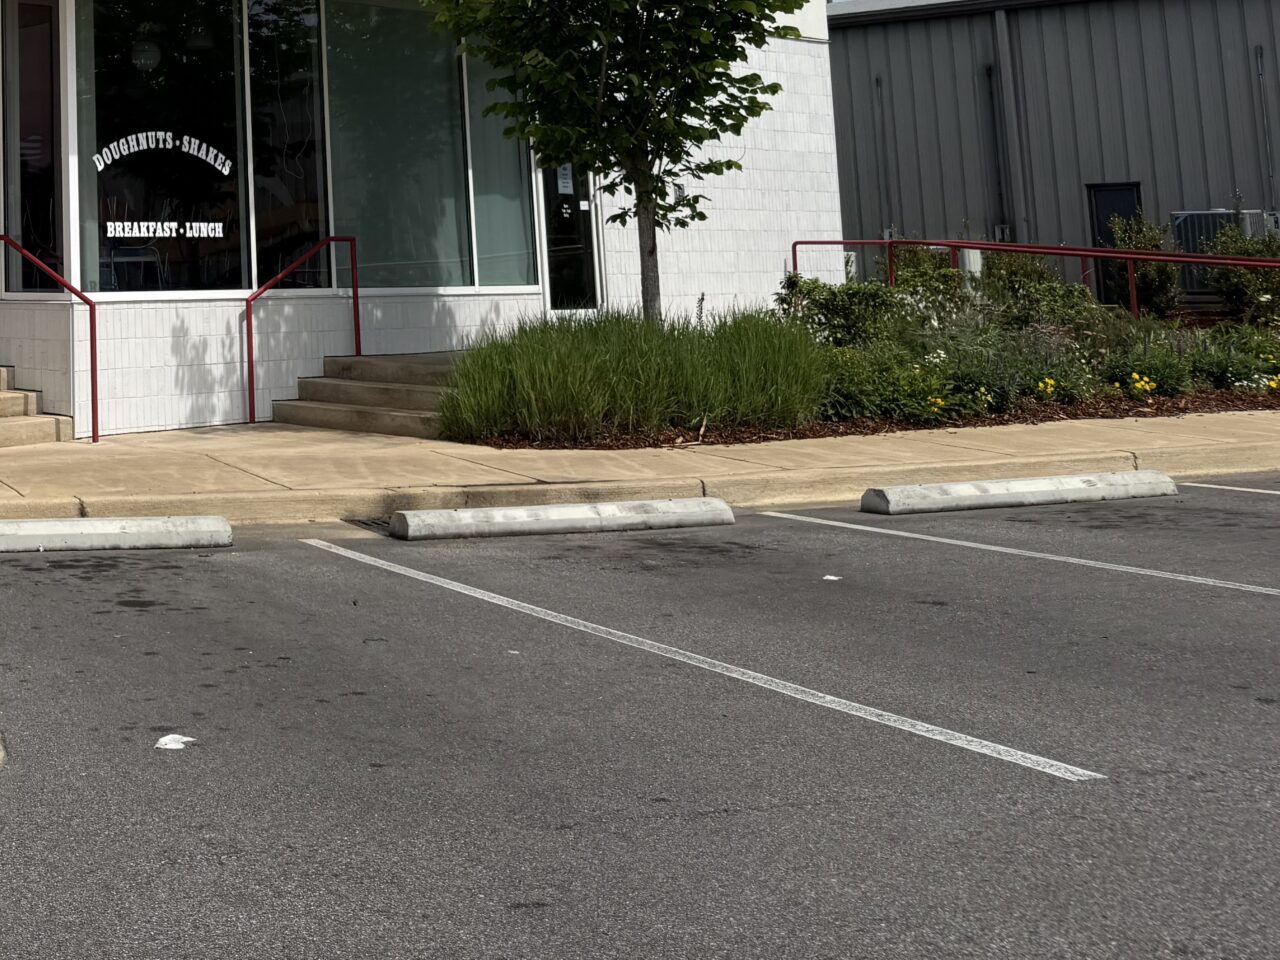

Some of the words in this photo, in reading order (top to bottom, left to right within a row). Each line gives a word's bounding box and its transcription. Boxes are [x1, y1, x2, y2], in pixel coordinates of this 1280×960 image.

[91, 131, 173, 172] DOUGHNUTS
[181, 135, 232, 176] SHAKES
[106, 221, 178, 238] BREAKFAST
[185, 221, 224, 238] LUNCH
